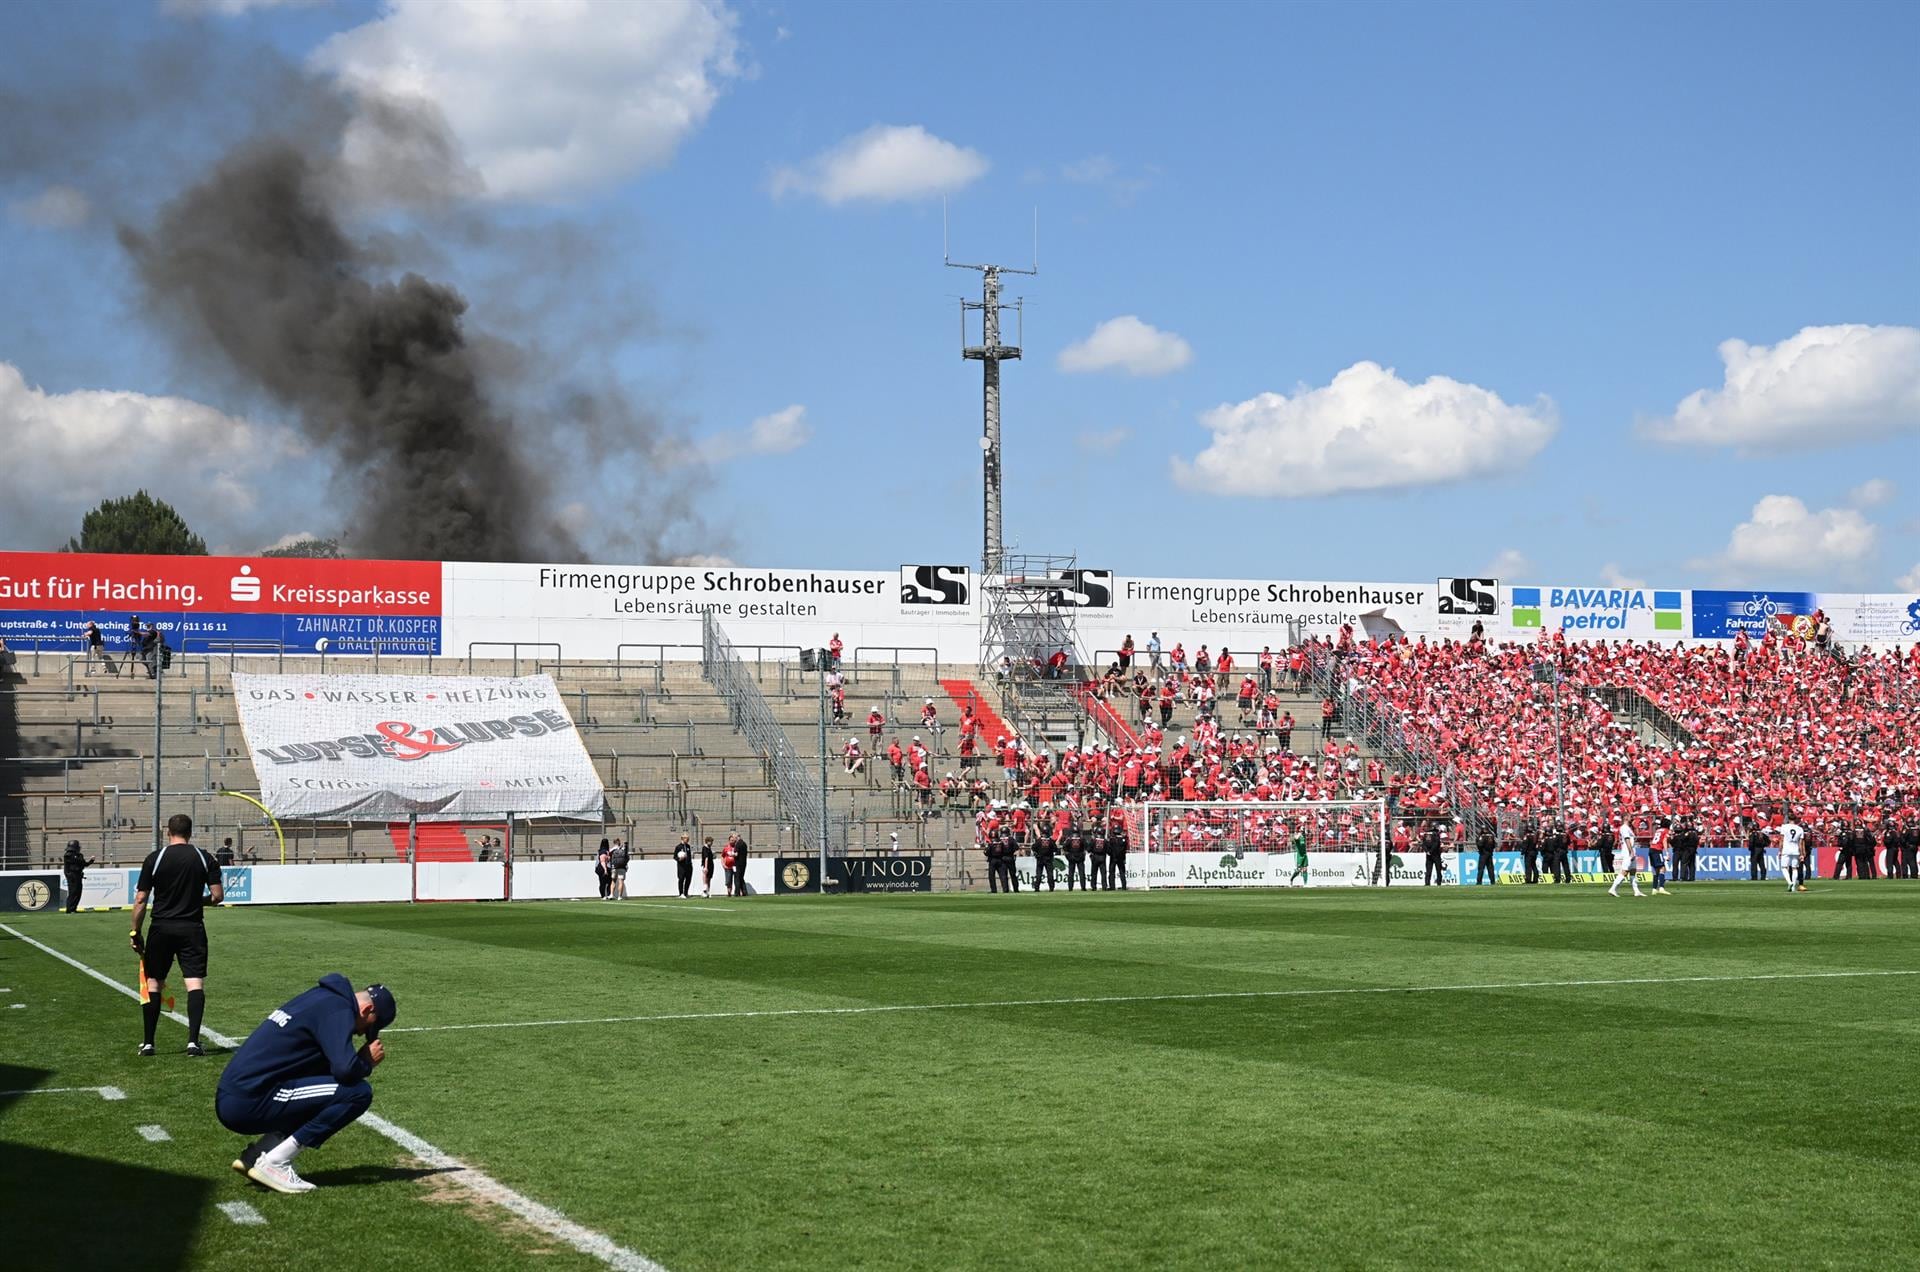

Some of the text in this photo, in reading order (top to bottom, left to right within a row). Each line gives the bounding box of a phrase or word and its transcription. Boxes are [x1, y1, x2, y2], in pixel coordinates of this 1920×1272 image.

[0, 576, 203, 606] Gut für Haching.
[540, 568, 885, 594] Firmengruppe Schrobenhauser
[272, 584, 430, 607] Kreissparkasse
[1127, 581, 1424, 605] Firmengruppe Schrobenhauser
[1551, 589, 1645, 609] BAVARIA
[614, 597, 817, 618] Lebensräume gestalten
[1192, 609, 1293, 624] Lebensräume
[50, 620, 57, 629] 4
[156, 622, 174, 631] 089
[183, 622, 200, 631] 611
[202, 623, 214, 631] 16
[216, 623, 228, 631] 11
[296, 617, 438, 633] ZAHNARZT DR.KOSPER
[1561, 609, 1627, 629] petrol
[1725, 617, 1766, 629] Fahrrad
[250, 687, 547, 703] GAS WASSER HEIZUNG
[432, 709, 572, 744] LUPSE
[1789, 829, 1797, 840] 9
[1186, 864, 1266, 885] Alpenbauer
[1275, 868, 1292, 877] Das
[866, 880, 920, 889] www.vinoda.de
